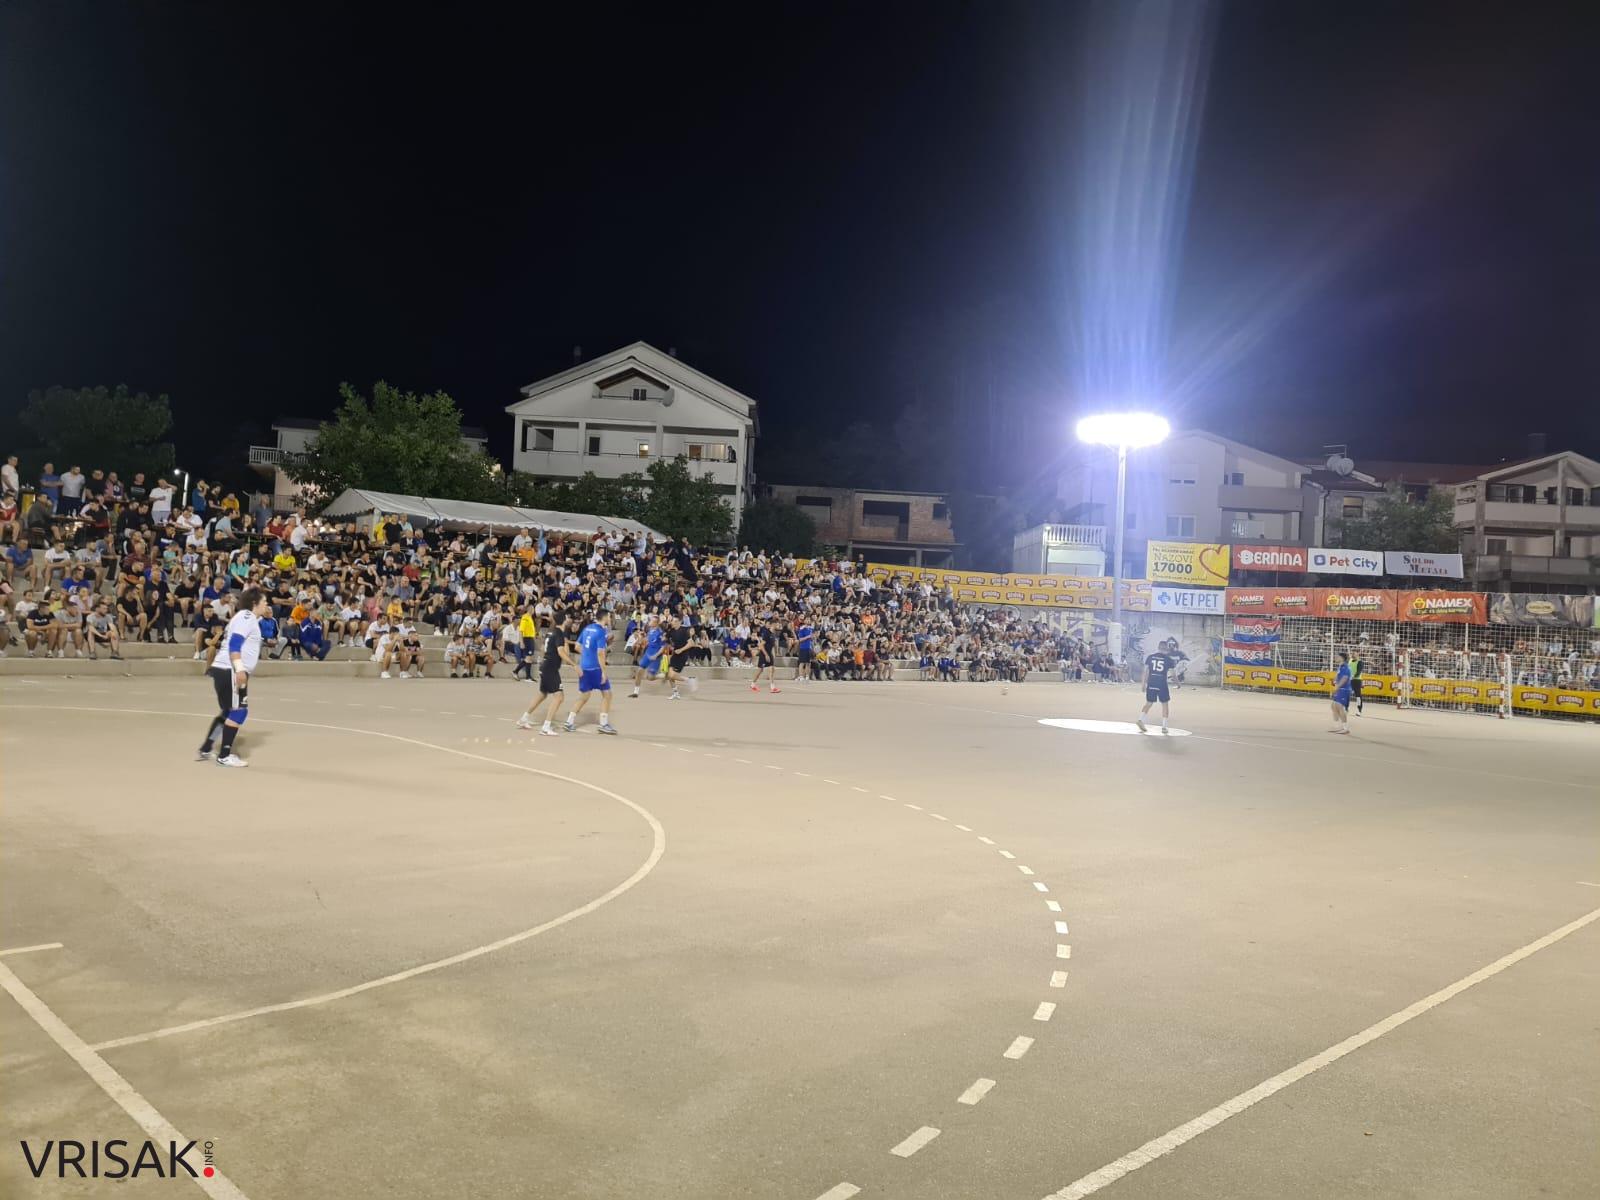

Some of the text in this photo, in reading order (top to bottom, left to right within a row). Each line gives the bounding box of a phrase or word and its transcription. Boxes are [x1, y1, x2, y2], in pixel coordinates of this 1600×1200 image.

[1154, 553, 1193, 563] NAZOVI
[1240, 549, 1303, 566] BERNINA
[1329, 556, 1378, 571] Pet City
[1152, 562, 1193, 574] 17000
[1174, 592, 1219, 608] VET PET
[1339, 595, 1382, 605] NAMEX
[1426, 598, 1472, 608] NAMEX
[1151, 659, 1165, 672] 15
